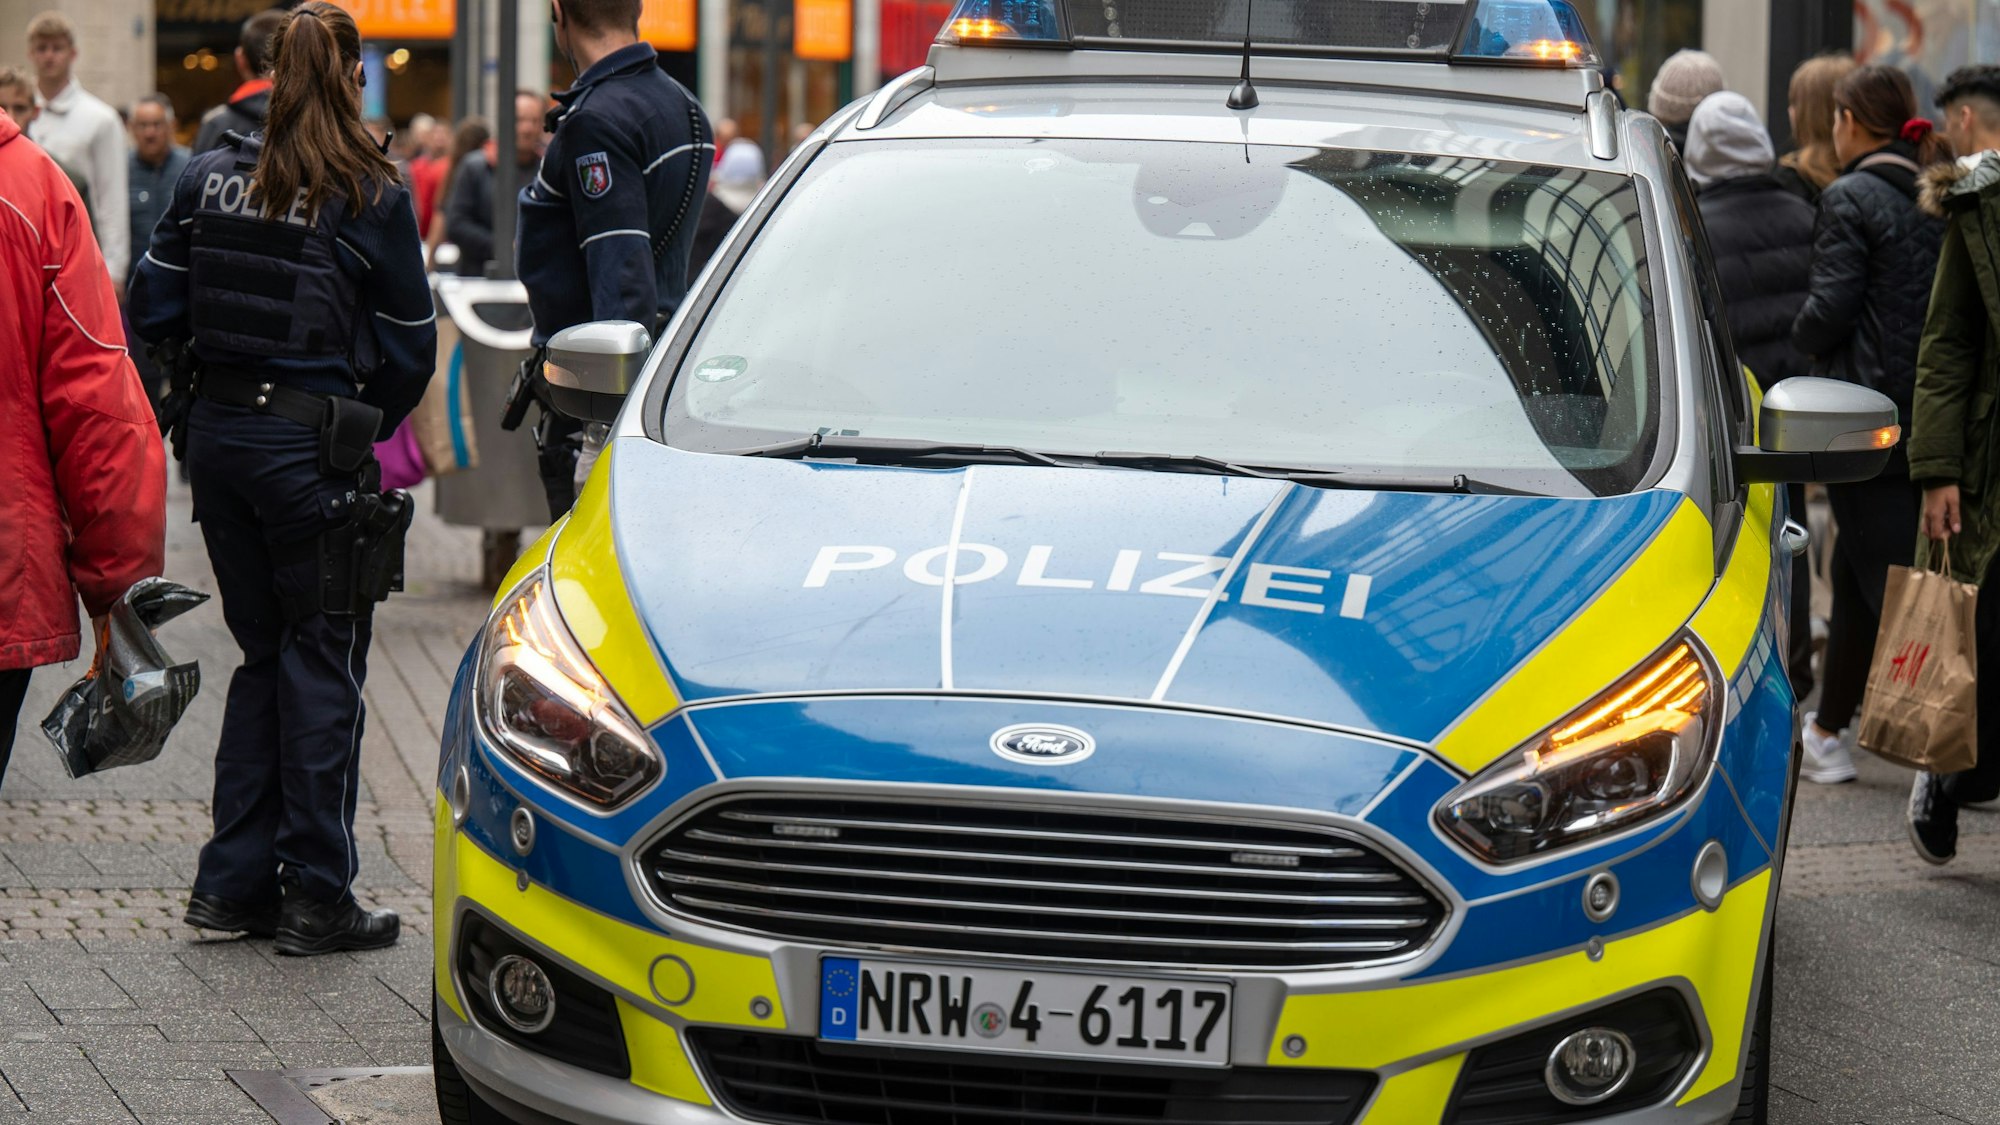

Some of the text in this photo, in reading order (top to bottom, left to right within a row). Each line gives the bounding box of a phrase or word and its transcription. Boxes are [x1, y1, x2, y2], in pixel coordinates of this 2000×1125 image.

[200, 172, 320, 228] POLIEI
[801, 541, 1373, 620] POLIZEI
[1016, 733, 1067, 755] Ford
[831, 1007, 847, 1026] D
[860, 968, 1227, 1053] NRW 4-6117
